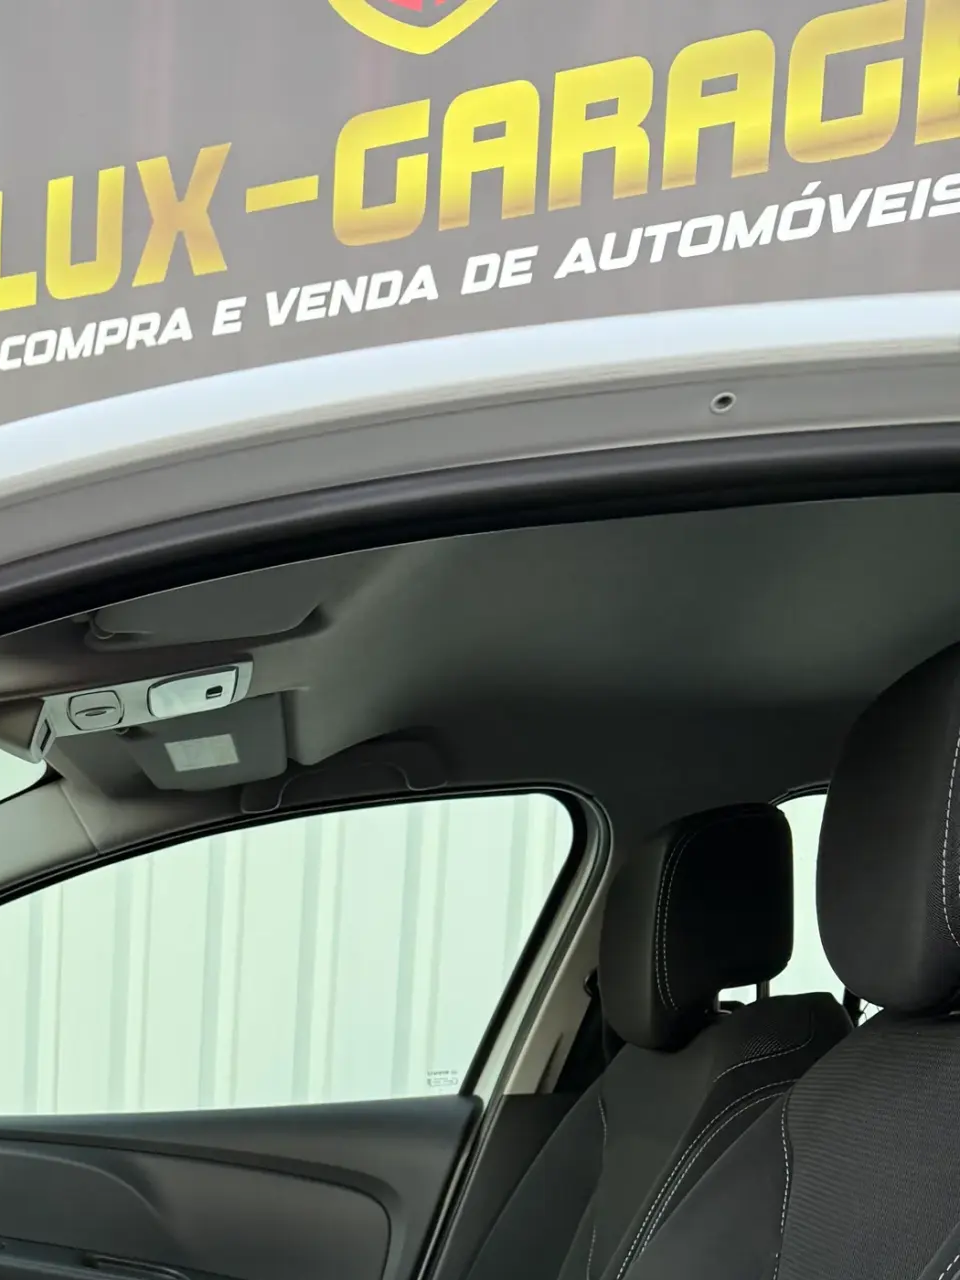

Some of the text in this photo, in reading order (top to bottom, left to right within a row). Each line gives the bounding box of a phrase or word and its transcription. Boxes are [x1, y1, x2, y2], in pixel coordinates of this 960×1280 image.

[212, 296, 247, 336] E
[266, 265, 438, 327] VENDA
[461, 246, 538, 296] DE
[554, 172, 960, 279] AUTOMÓVEIS
